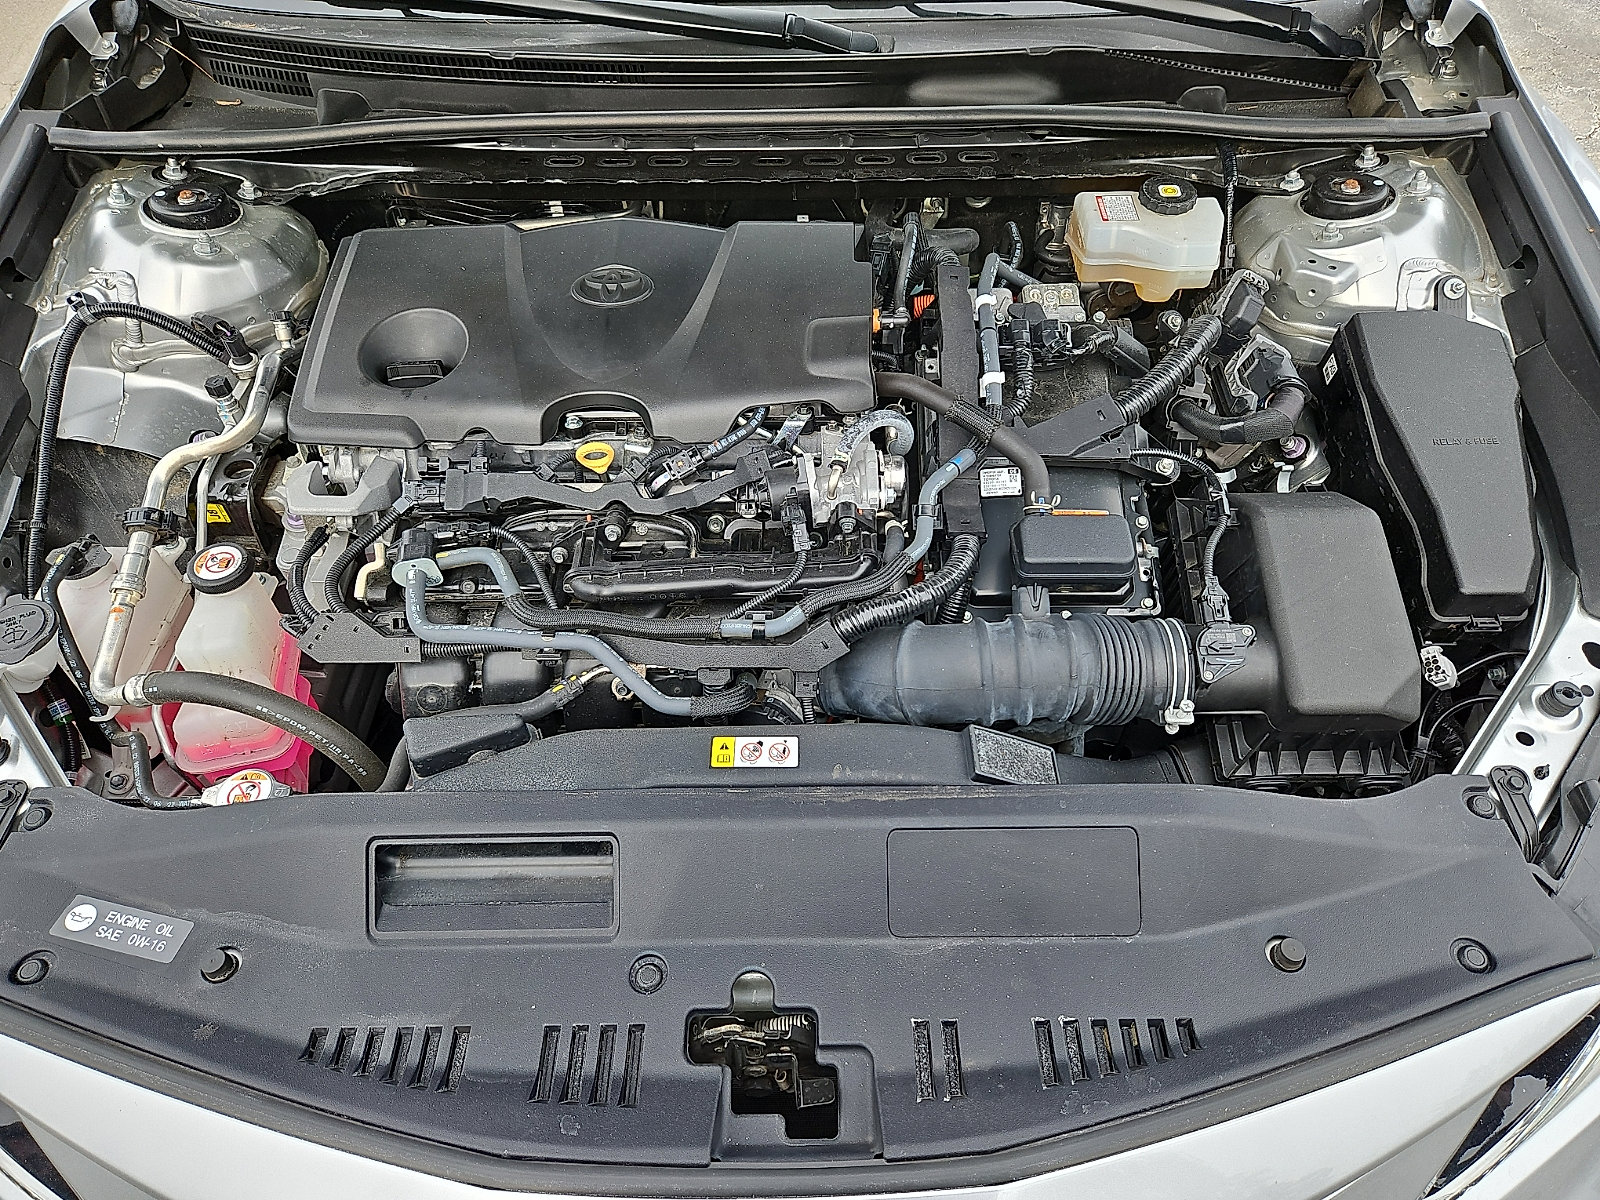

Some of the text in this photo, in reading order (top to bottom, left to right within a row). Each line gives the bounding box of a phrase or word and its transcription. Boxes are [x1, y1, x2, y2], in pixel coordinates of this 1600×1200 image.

[1432, 438, 1462, 446] RELAY
[1474, 437, 1500, 445] FUSE
[105, 911, 174, 938] ENGINE OIL
[96, 925, 167, 952] SAE 0W-16
